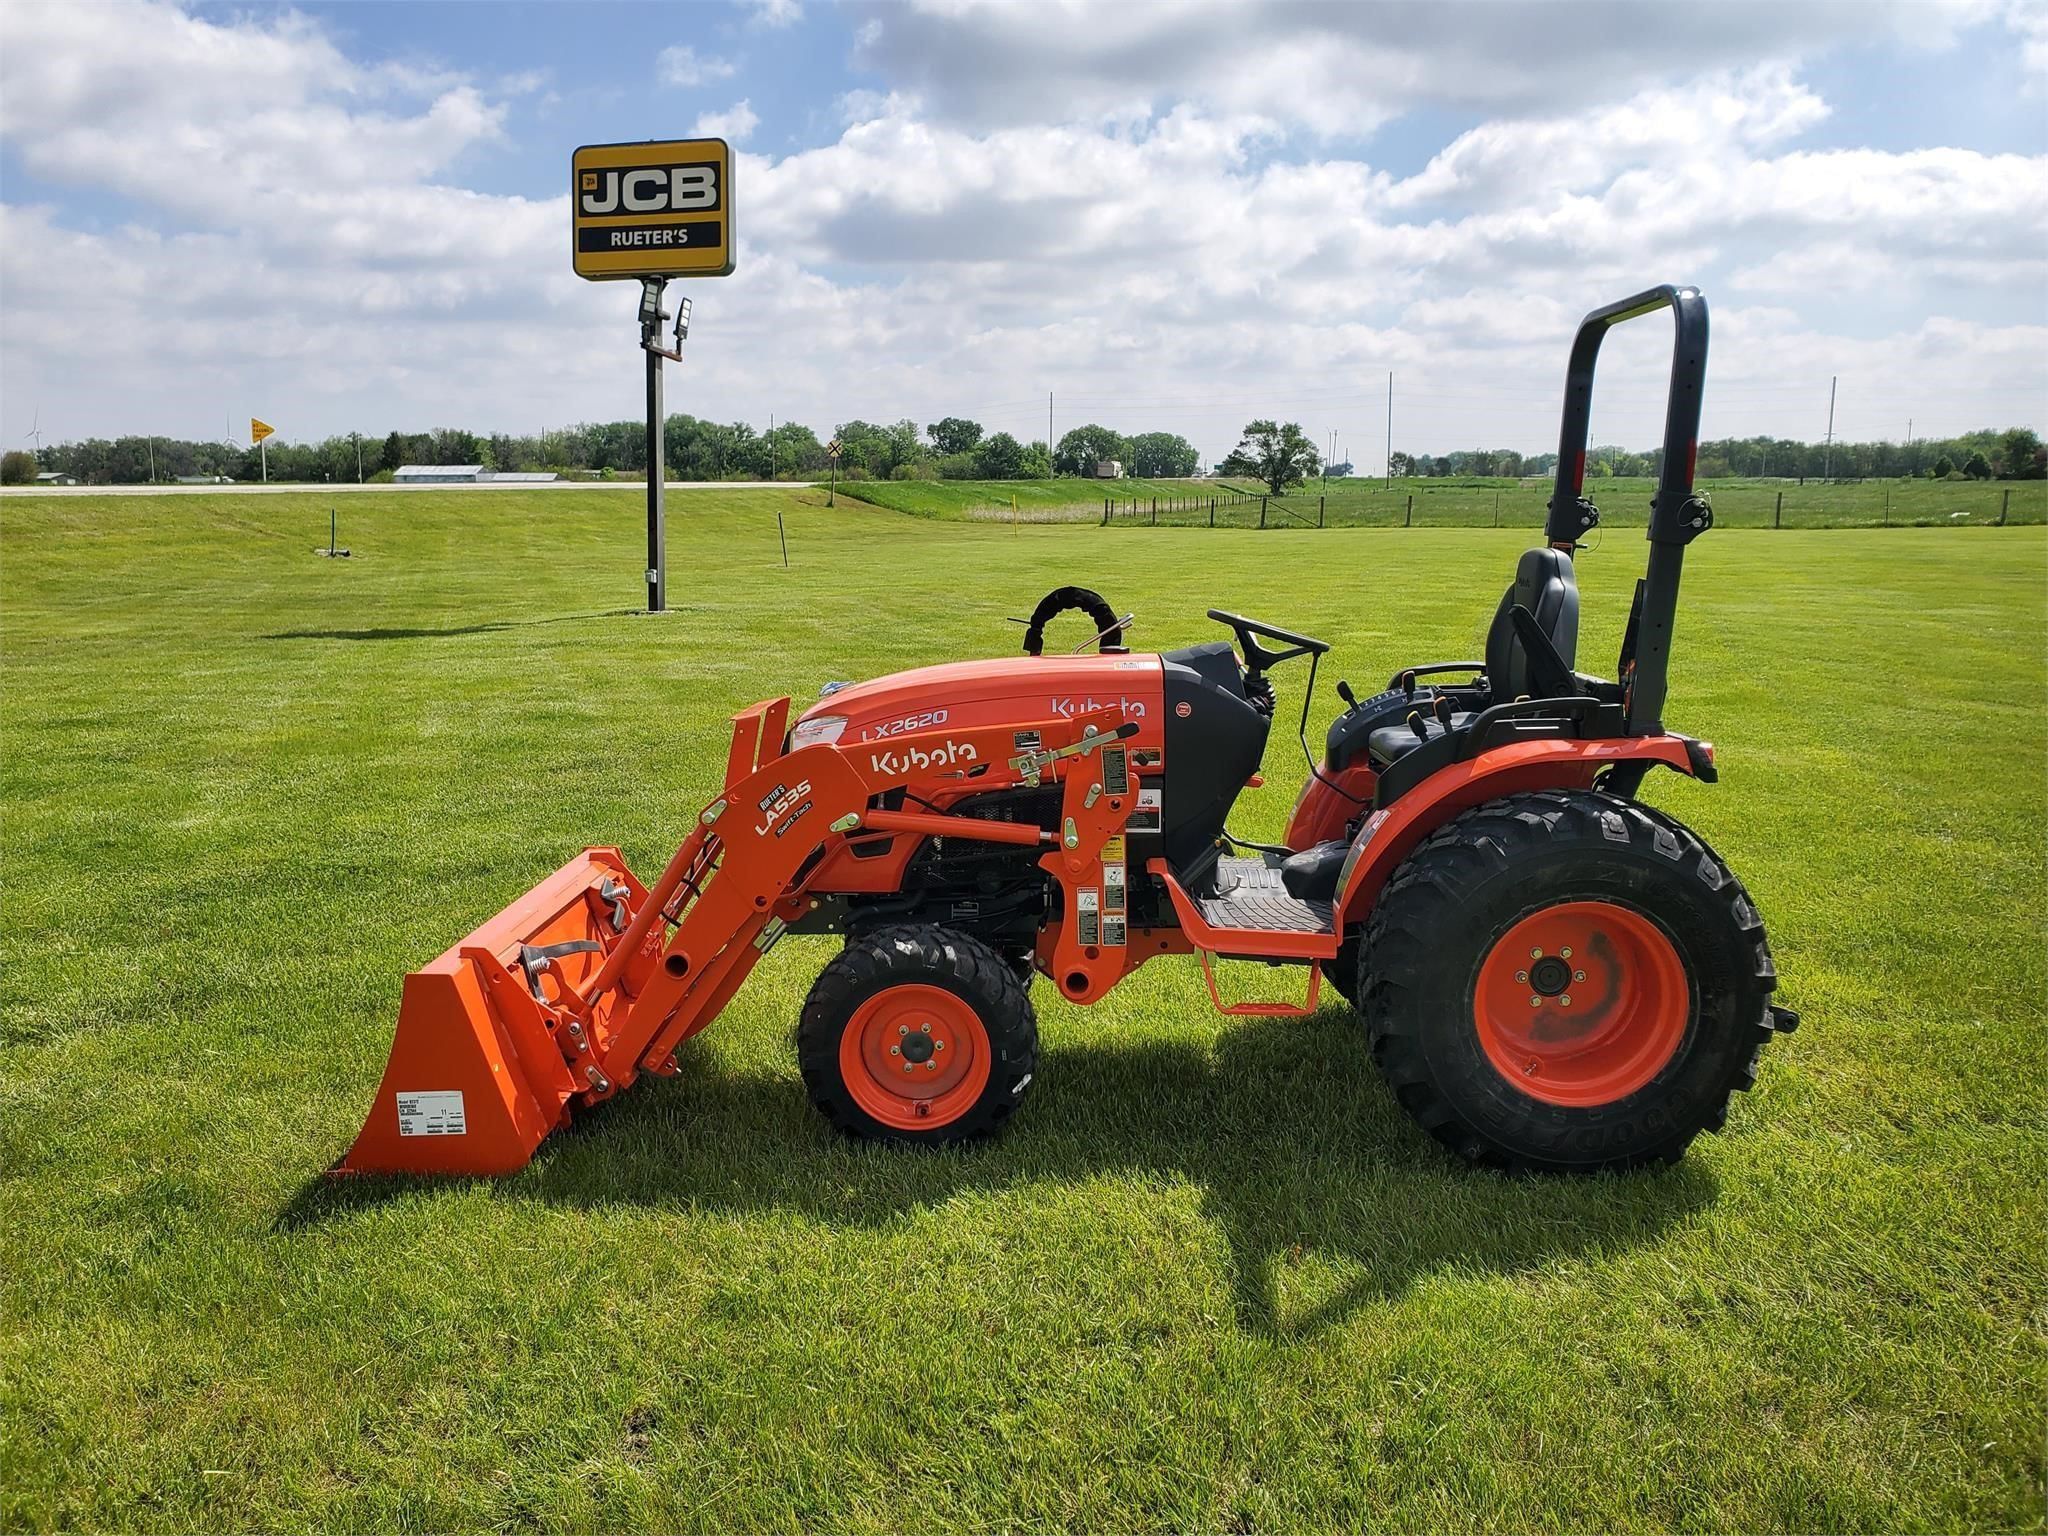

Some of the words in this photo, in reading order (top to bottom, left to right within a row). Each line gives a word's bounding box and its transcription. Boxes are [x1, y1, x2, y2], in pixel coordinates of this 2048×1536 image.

[582, 166, 717, 213] JCB
[611, 229, 688, 246] RUETER'S
[861, 709, 948, 743] LX2620
[871, 740, 977, 775] Kubota
[755, 779, 812, 836] LA535
[777, 802, 812, 836] Swift-Tach
